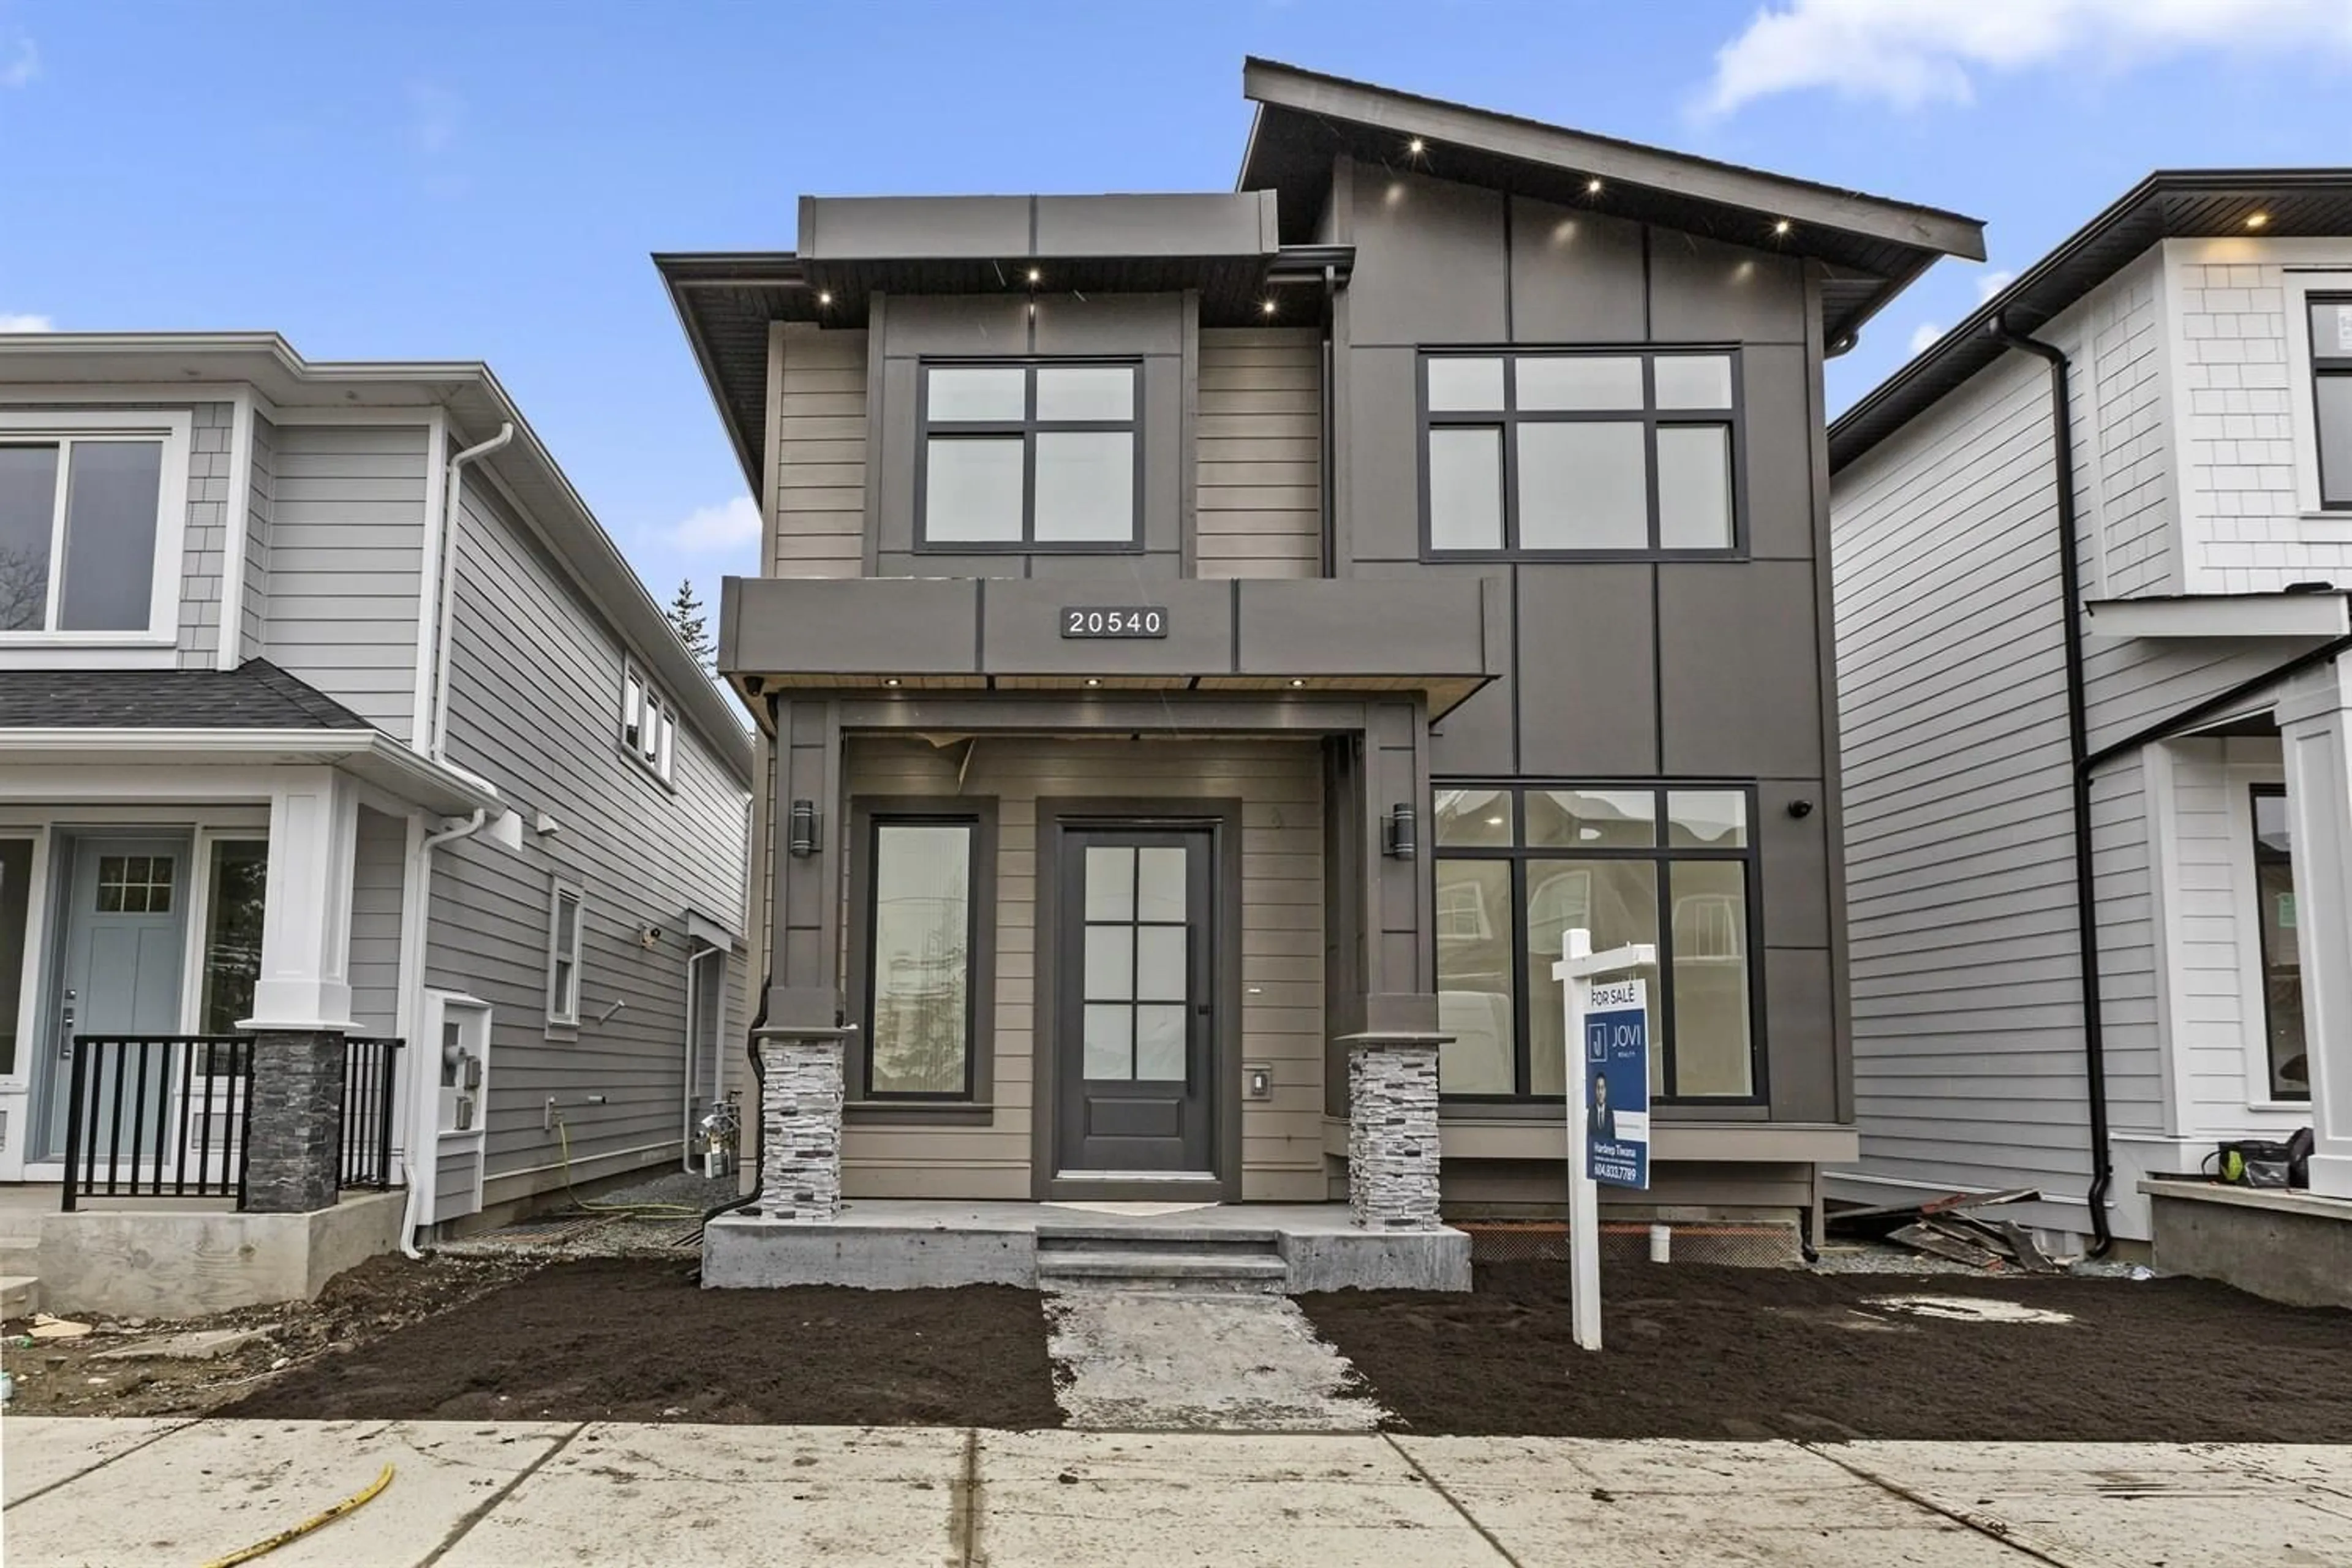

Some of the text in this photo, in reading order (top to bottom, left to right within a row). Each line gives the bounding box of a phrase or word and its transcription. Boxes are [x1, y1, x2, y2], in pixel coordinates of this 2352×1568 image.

[1069, 612, 1159, 632] 20540
[1592, 987, 1634, 1006] FOR SALE
[1612, 1024, 1641, 1047] JOVI
